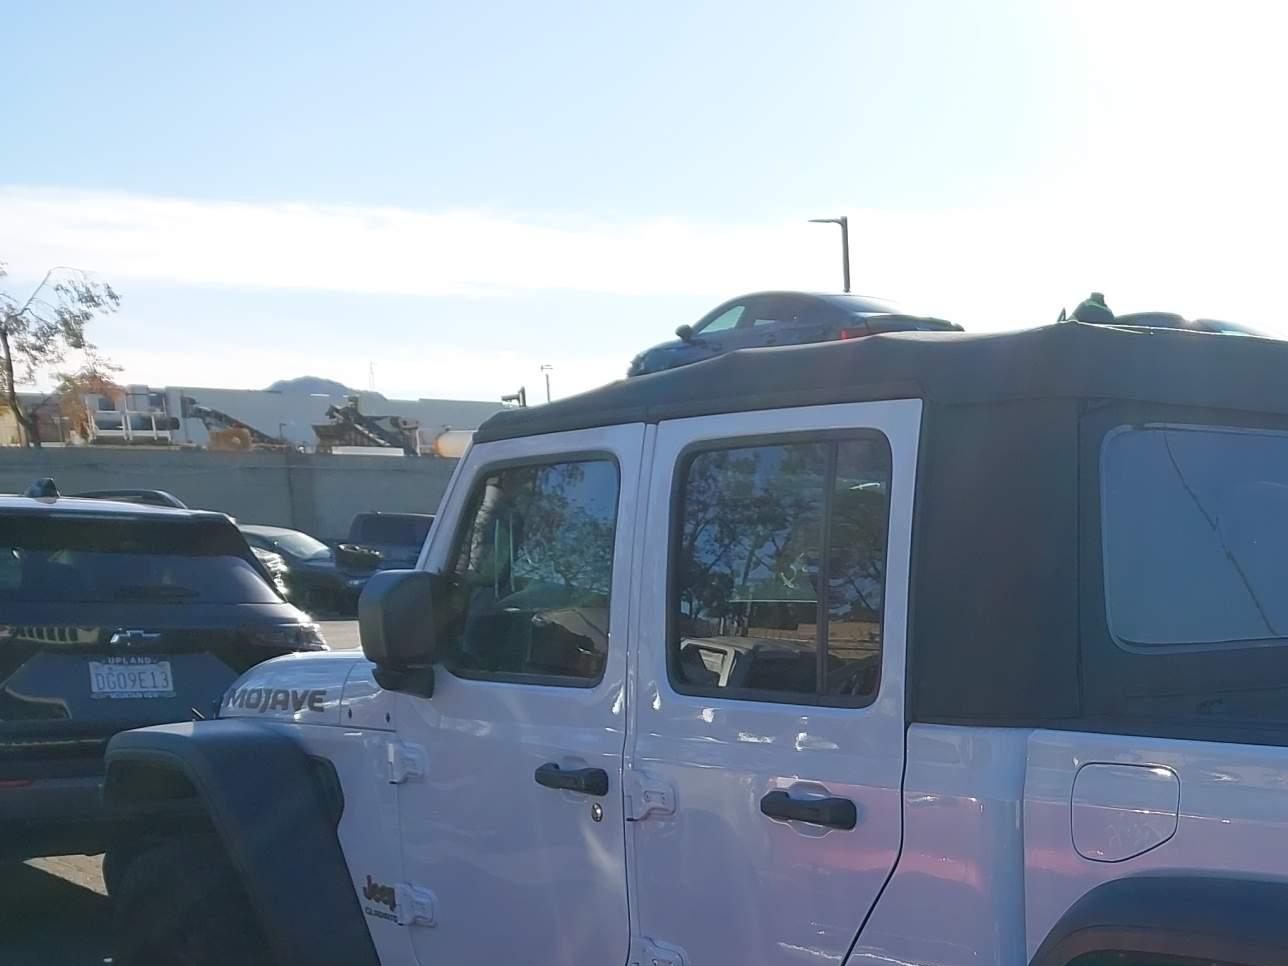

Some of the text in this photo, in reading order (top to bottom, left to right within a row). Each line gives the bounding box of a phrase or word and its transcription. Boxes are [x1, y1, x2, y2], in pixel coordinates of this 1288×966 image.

[106, 656, 153, 665] UPLAND
[224, 687, 327, 713] MOJAVE
[363, 874, 397, 911] Jeep
